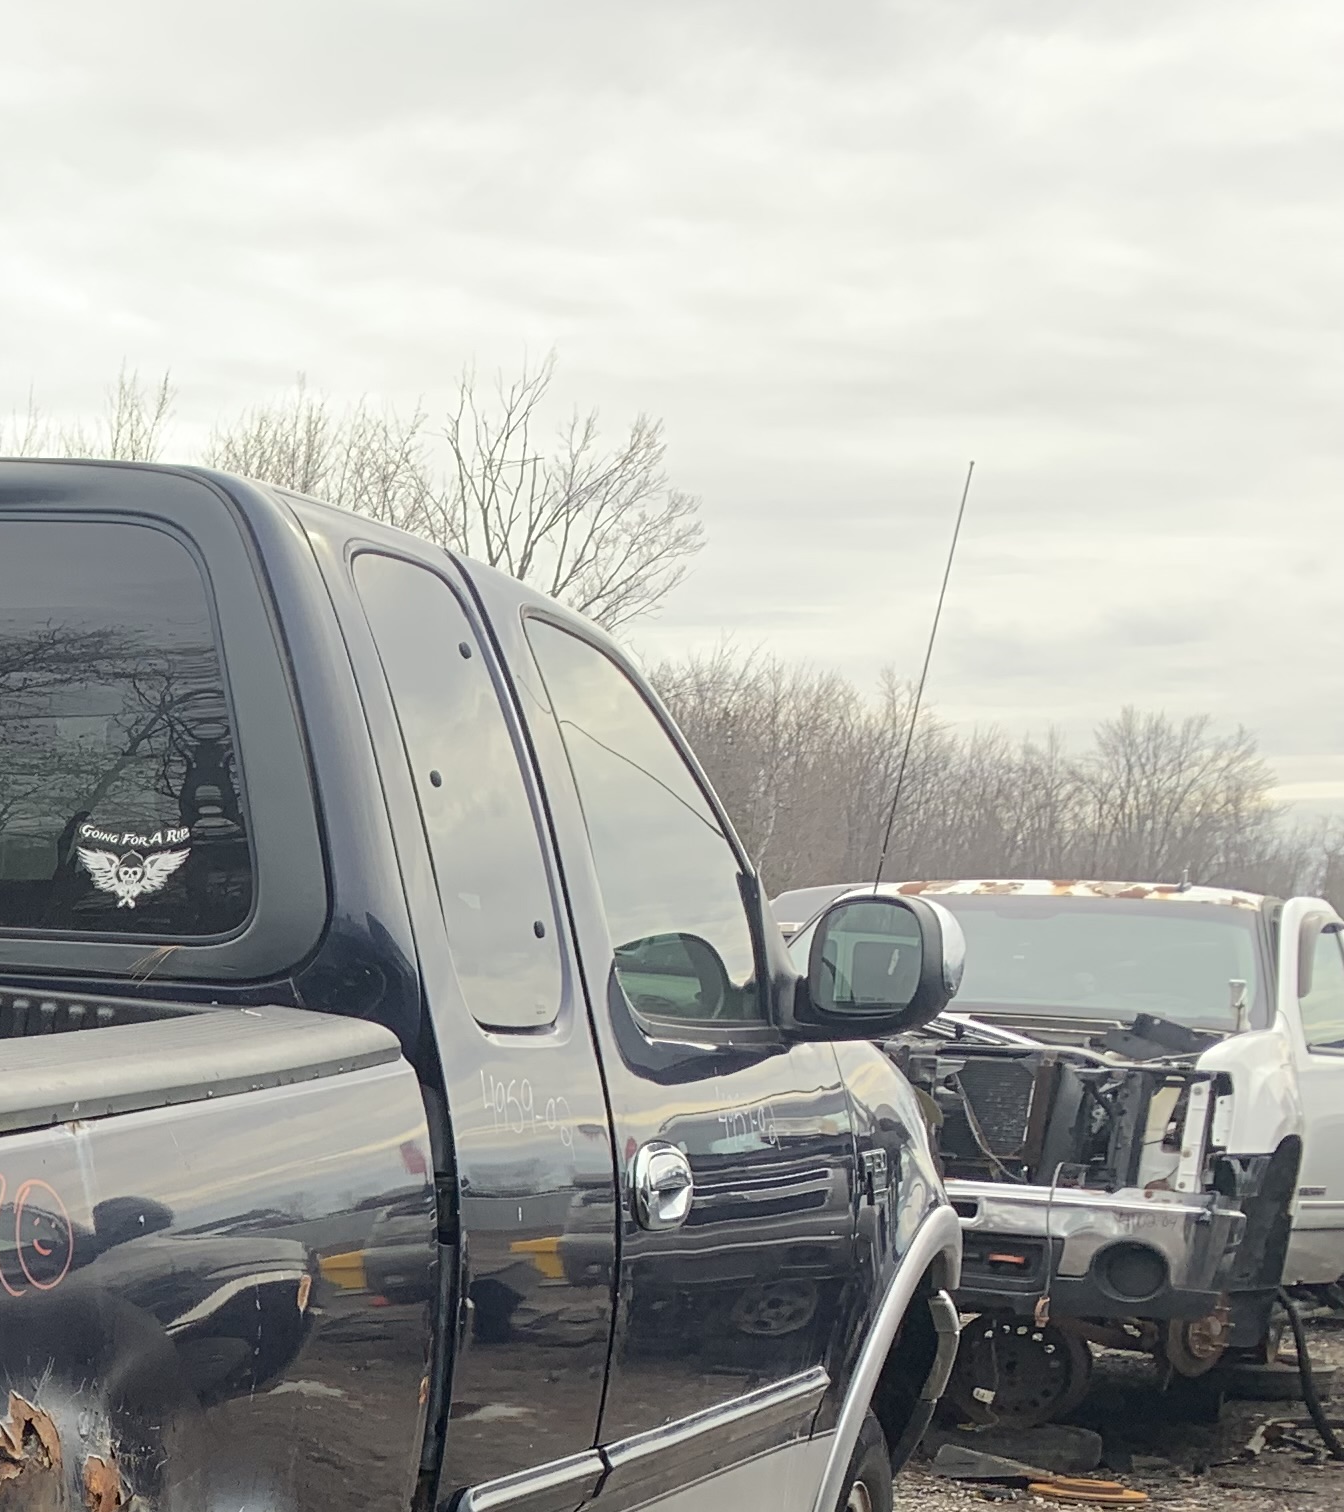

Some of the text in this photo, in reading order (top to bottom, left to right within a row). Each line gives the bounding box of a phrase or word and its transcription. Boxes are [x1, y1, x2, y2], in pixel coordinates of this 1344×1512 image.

[80, 824, 191, 847] GOING FOR A RIP
